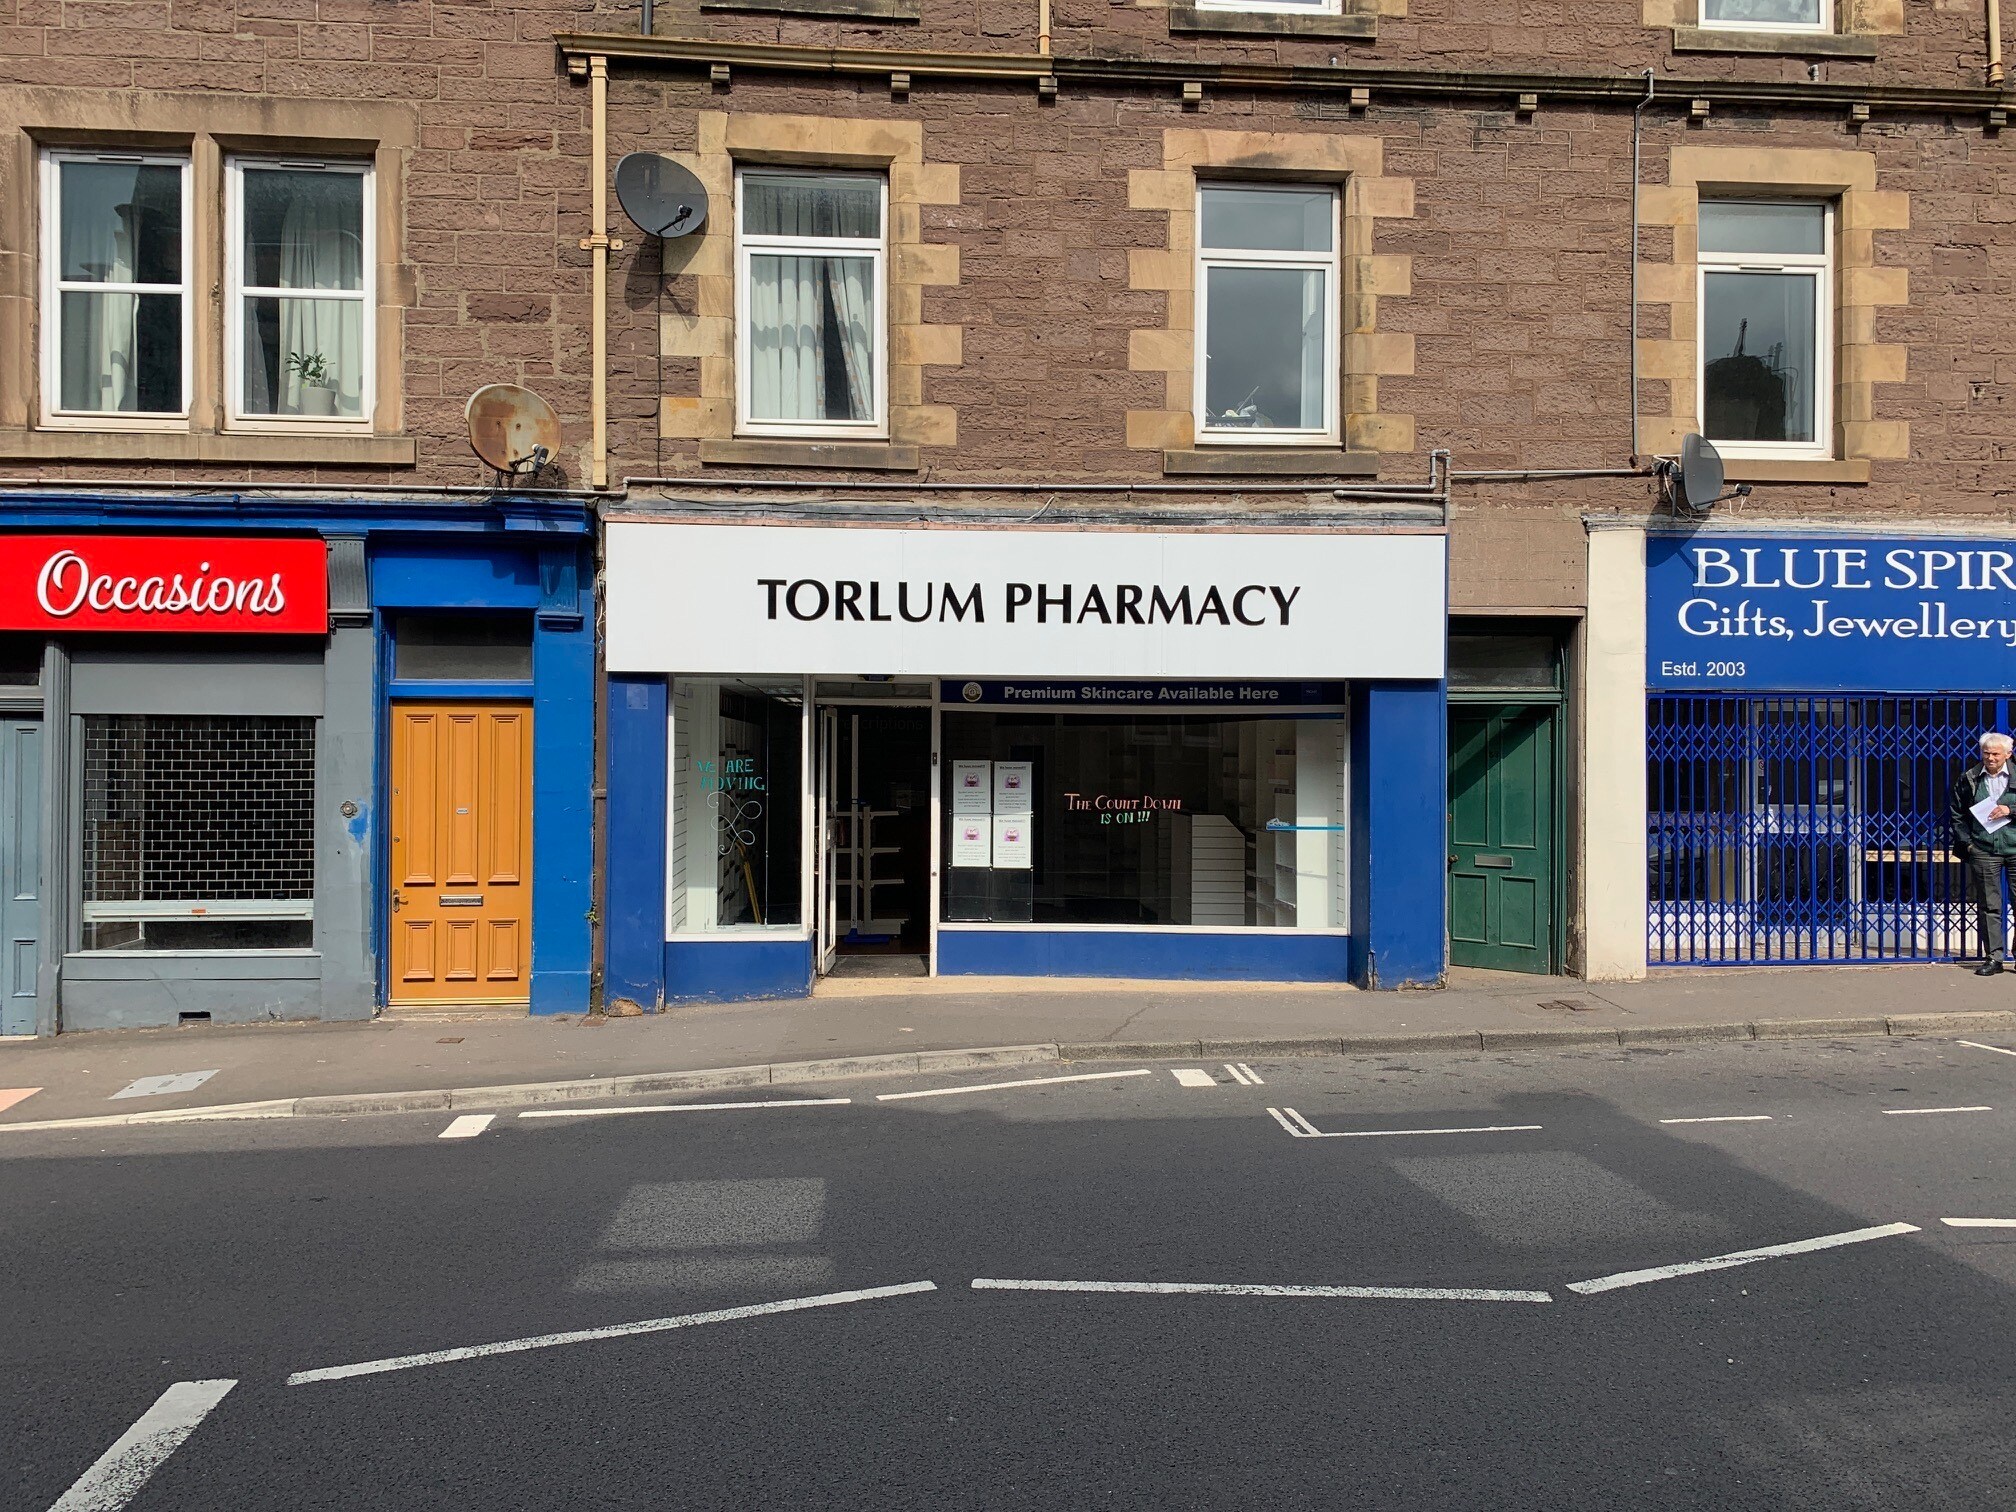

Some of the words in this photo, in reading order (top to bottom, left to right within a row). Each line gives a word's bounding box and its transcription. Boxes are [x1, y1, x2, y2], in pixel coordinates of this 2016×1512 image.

[1691, 547, 1871, 589] BLUE
[1884, 548, 2016, 591] SPIR
[37, 549, 286, 616] Occasions
[757, 578, 985, 623] TORLUM
[1006, 582, 1301, 626] PHARMACY
[1677, 597, 1794, 642] Gifts,
[1803, 599, 2016, 647] Jewellery
[1661, 661, 1702, 676] Estd.
[1706, 661, 1746, 677] 2003
[1004, 686, 1076, 699] Premium
[1081, 686, 1153, 700] Skincare
[1158, 687, 1234, 700] Available
[1239, 687, 1279, 700] Here
[696, 760, 716, 773] WE
[725, 758, 754, 773] ARE
[700, 776, 766, 791] MOVING
[1100, 812, 1112, 825] IS
[1115, 812, 1134, 824] ON
